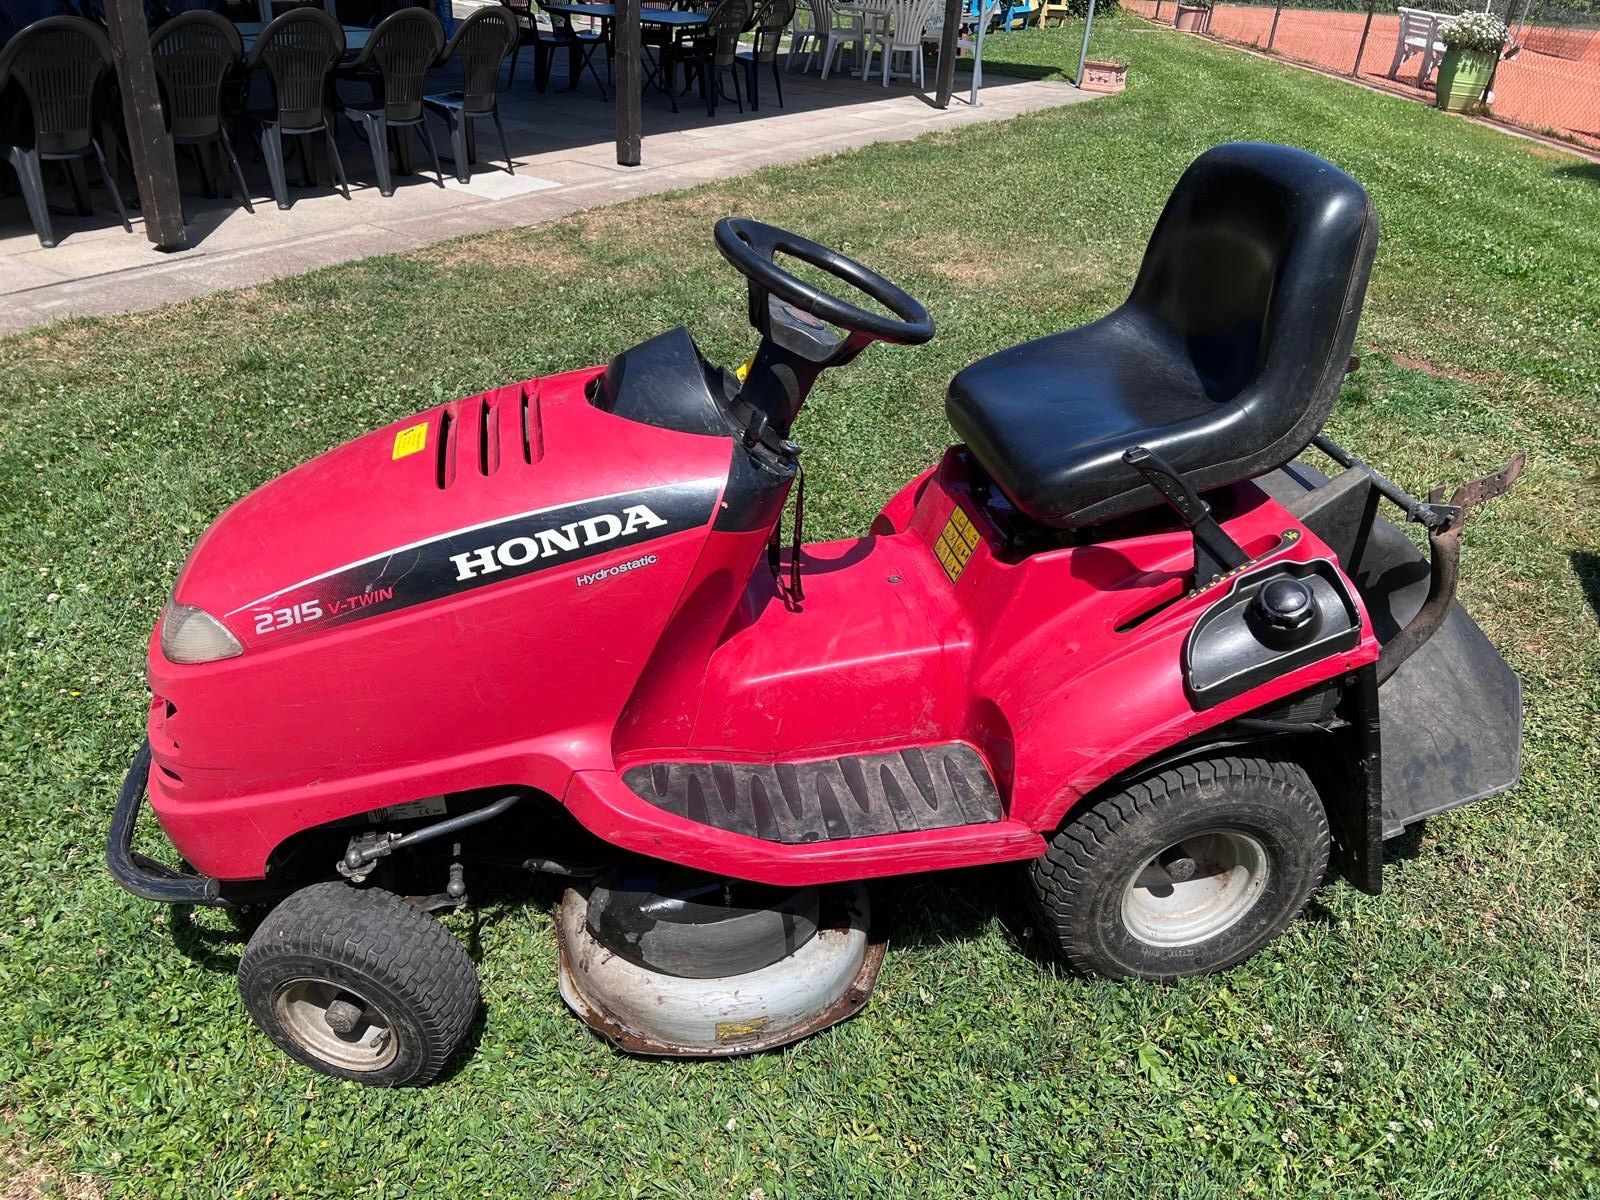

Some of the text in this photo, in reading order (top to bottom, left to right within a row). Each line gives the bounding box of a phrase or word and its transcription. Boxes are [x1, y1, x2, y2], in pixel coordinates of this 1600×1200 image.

[449, 504, 668, 581] HONDA
[576, 554, 658, 587] Hydrostatic
[254, 587, 393, 635] 2315 V-TWIN
